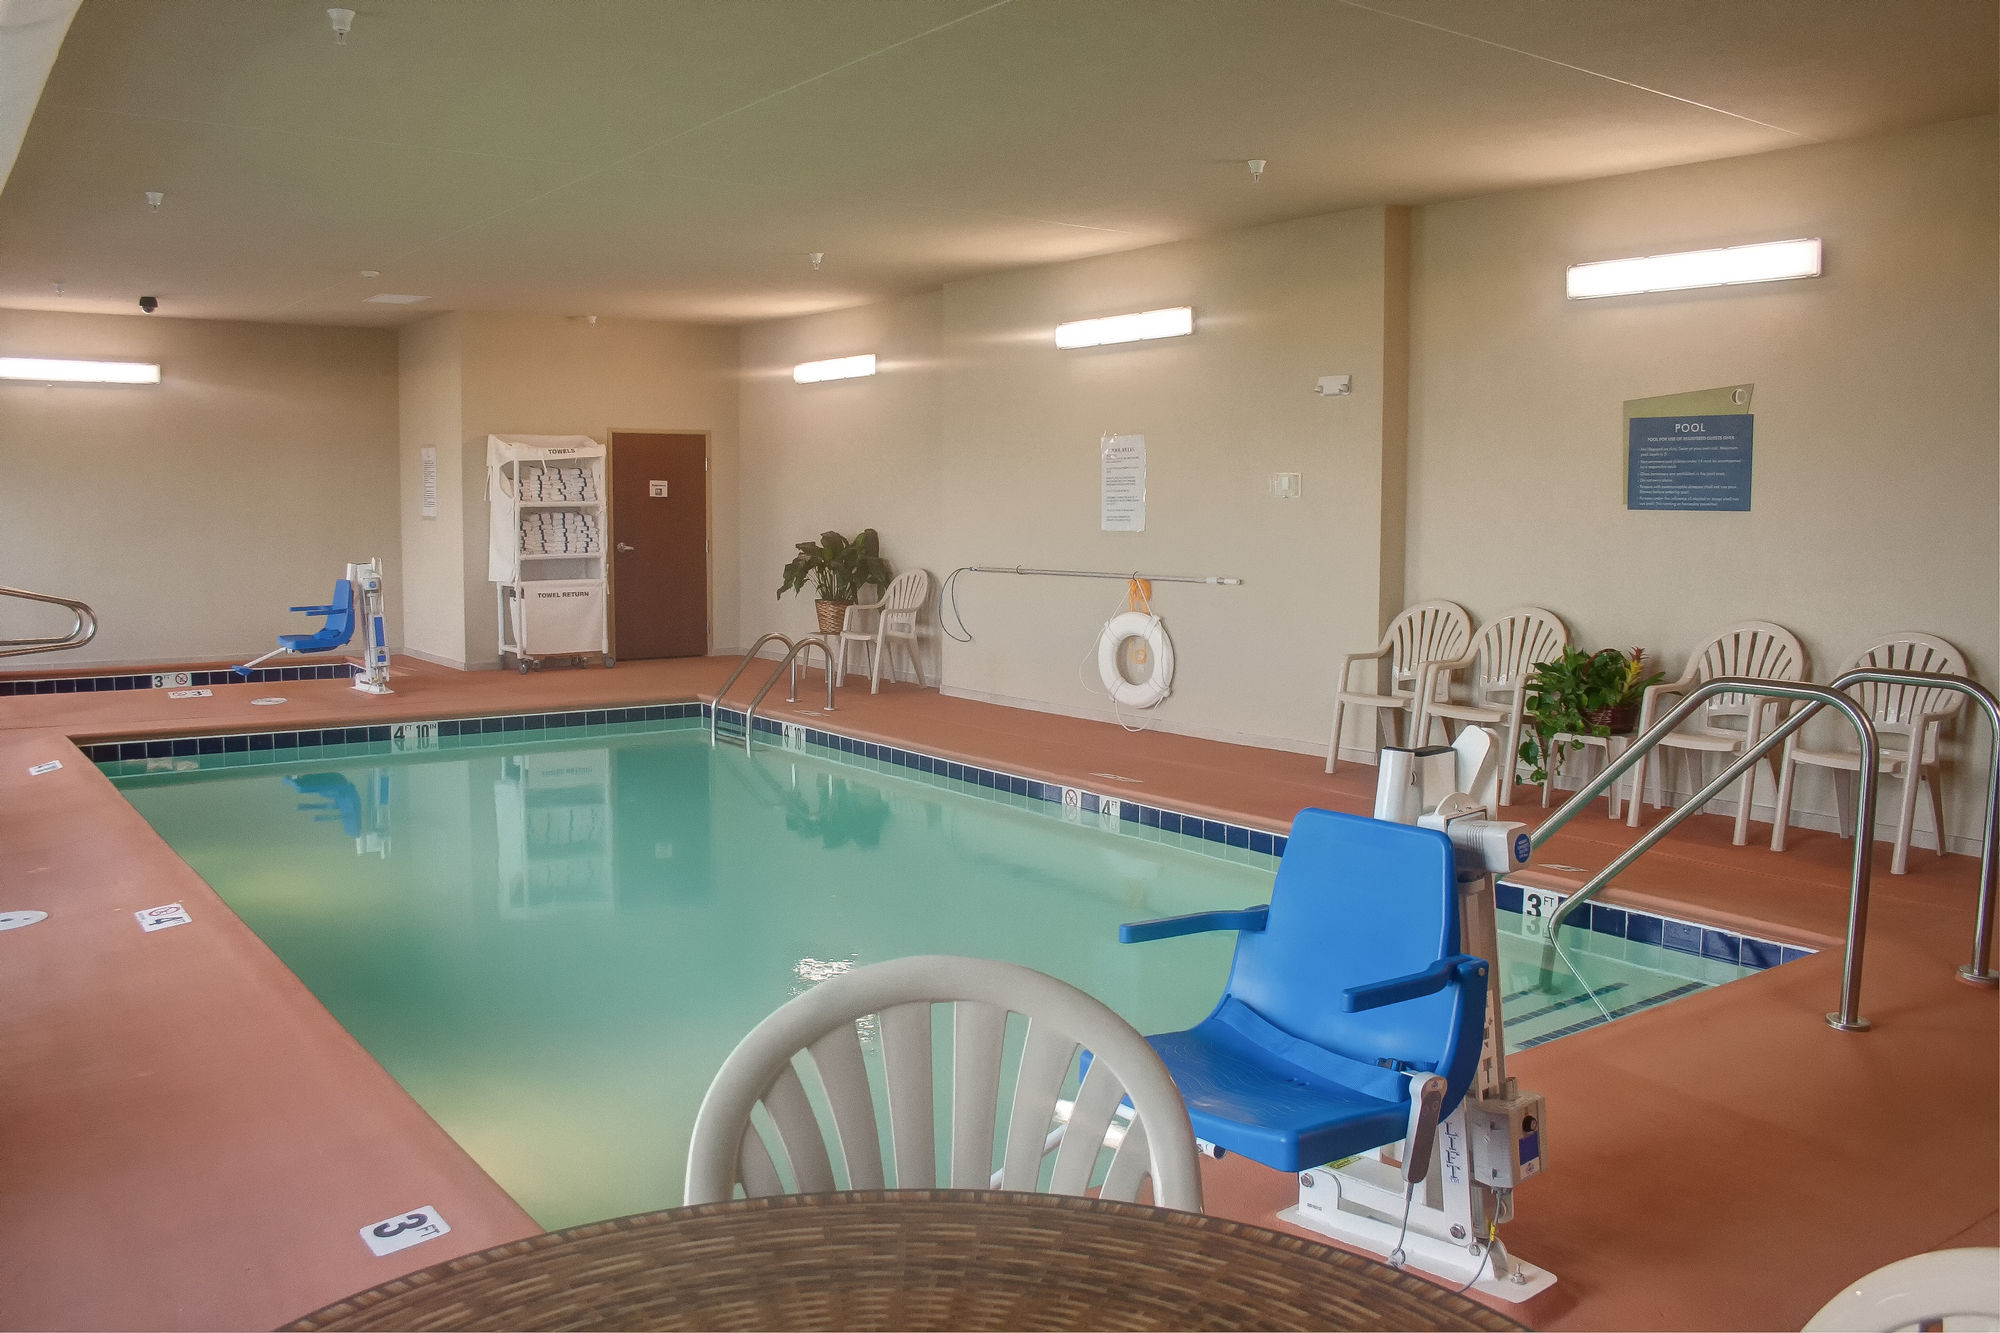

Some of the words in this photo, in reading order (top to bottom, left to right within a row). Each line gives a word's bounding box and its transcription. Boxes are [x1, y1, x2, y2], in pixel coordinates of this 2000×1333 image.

[1675, 423, 1706, 433] POOL
[154, 675, 164, 688] 3
[393, 725, 406, 739] 4
[416, 724, 430, 738] 10
[784, 724, 790, 738] 4
[1102, 799, 1112, 816] 4
[1526, 893, 1542, 917] 3
[1543, 895, 1555, 907] FT
[372, 1213, 429, 1238] 3
[416, 1223, 441, 1238] FT
